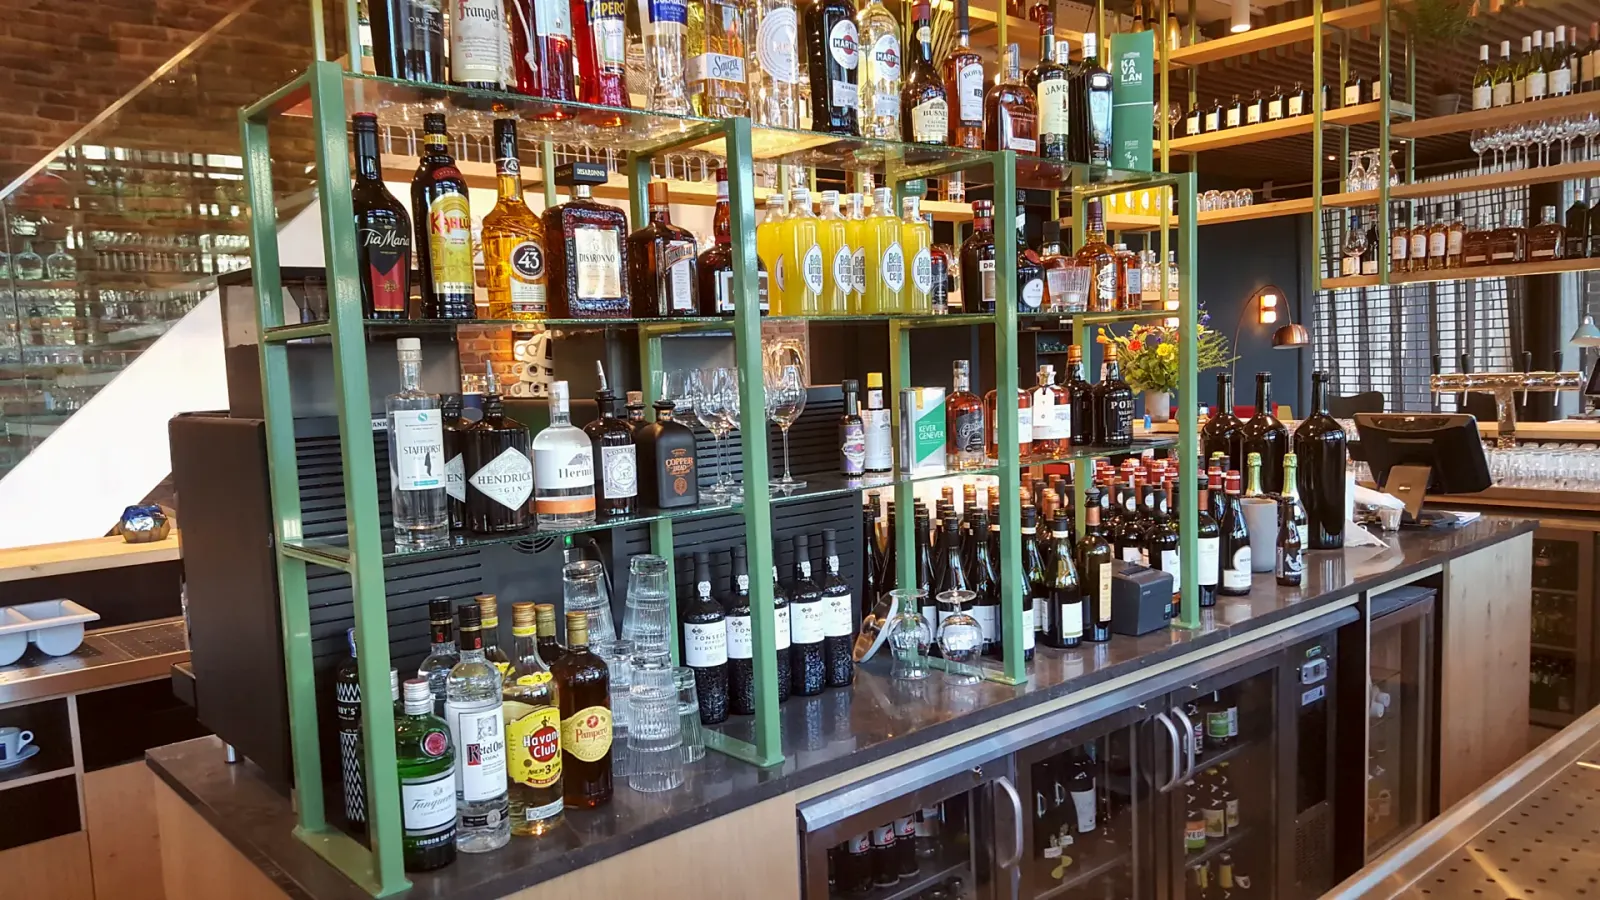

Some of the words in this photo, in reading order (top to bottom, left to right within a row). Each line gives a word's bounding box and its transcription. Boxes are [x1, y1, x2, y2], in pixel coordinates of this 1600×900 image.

[713, 56, 740, 77] Sauza
[1121, 59, 1136, 68] KA
[1122, 66, 1136, 75] VA
[1121, 72, 1143, 82] LAN
[359, 228, 382, 247] Tia
[380, 229, 410, 247] Maria
[518, 251, 540, 269] 43
[579, 253, 616, 263] DISARONNO
[918, 424, 936, 433] KEVER
[918, 431, 944, 440] GENEVER
[403, 444, 441, 455] STAFFHORST
[665, 457, 694, 466] COPPER
[575, 727, 608, 743] Pampero
[466, 742, 493, 765] Ketel
[533, 745, 556, 758] Club
[545, 764, 551, 775] 3
[416, 837, 440, 846] LONDON
